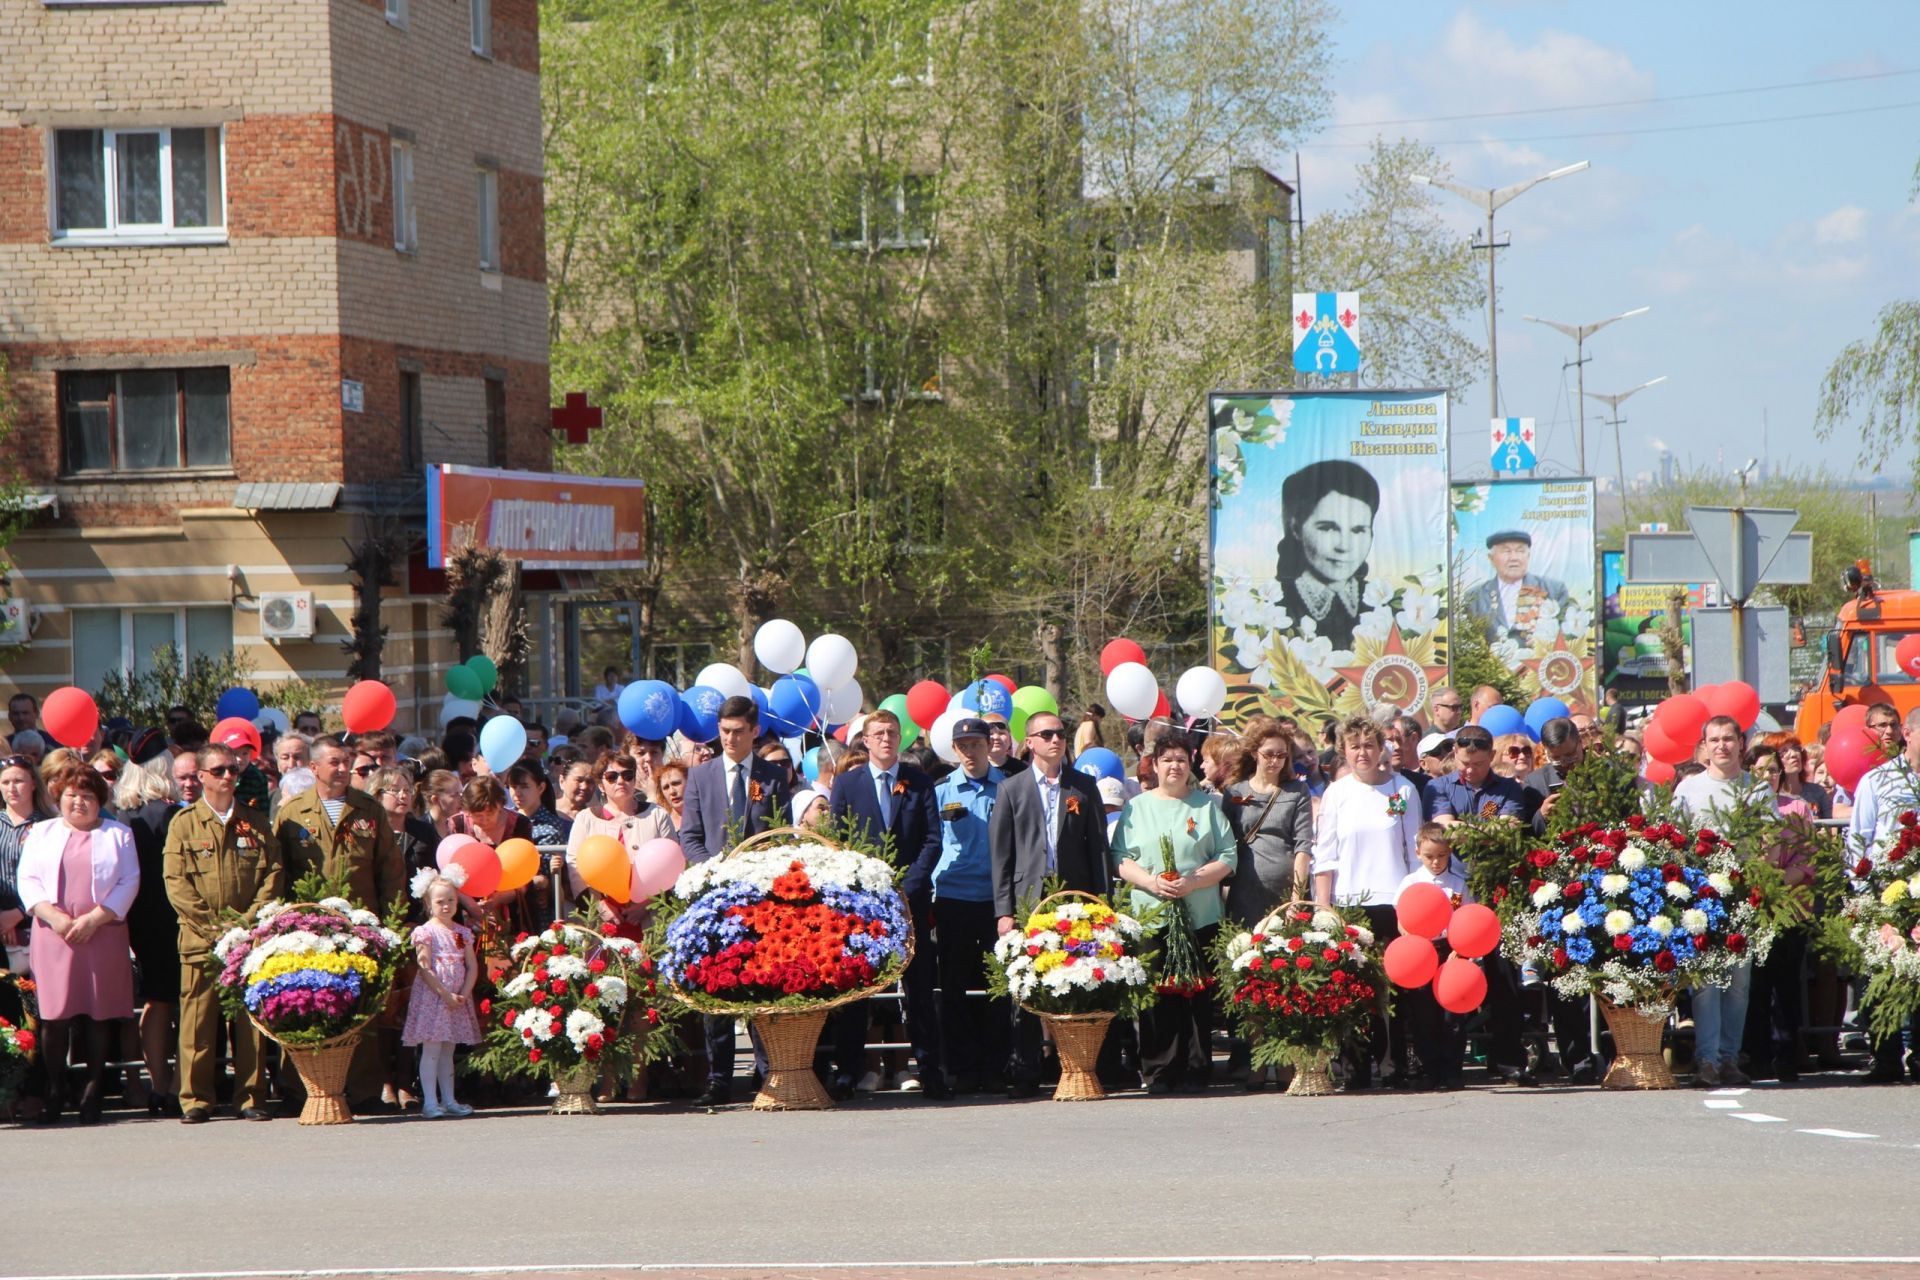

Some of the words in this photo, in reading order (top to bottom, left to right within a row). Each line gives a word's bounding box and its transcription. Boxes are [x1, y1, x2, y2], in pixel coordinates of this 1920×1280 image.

[1367, 400, 1438, 417] Лыкова
[1360, 421, 1438, 438] Клавдия
[1350, 440, 1438, 457] Ивановна
